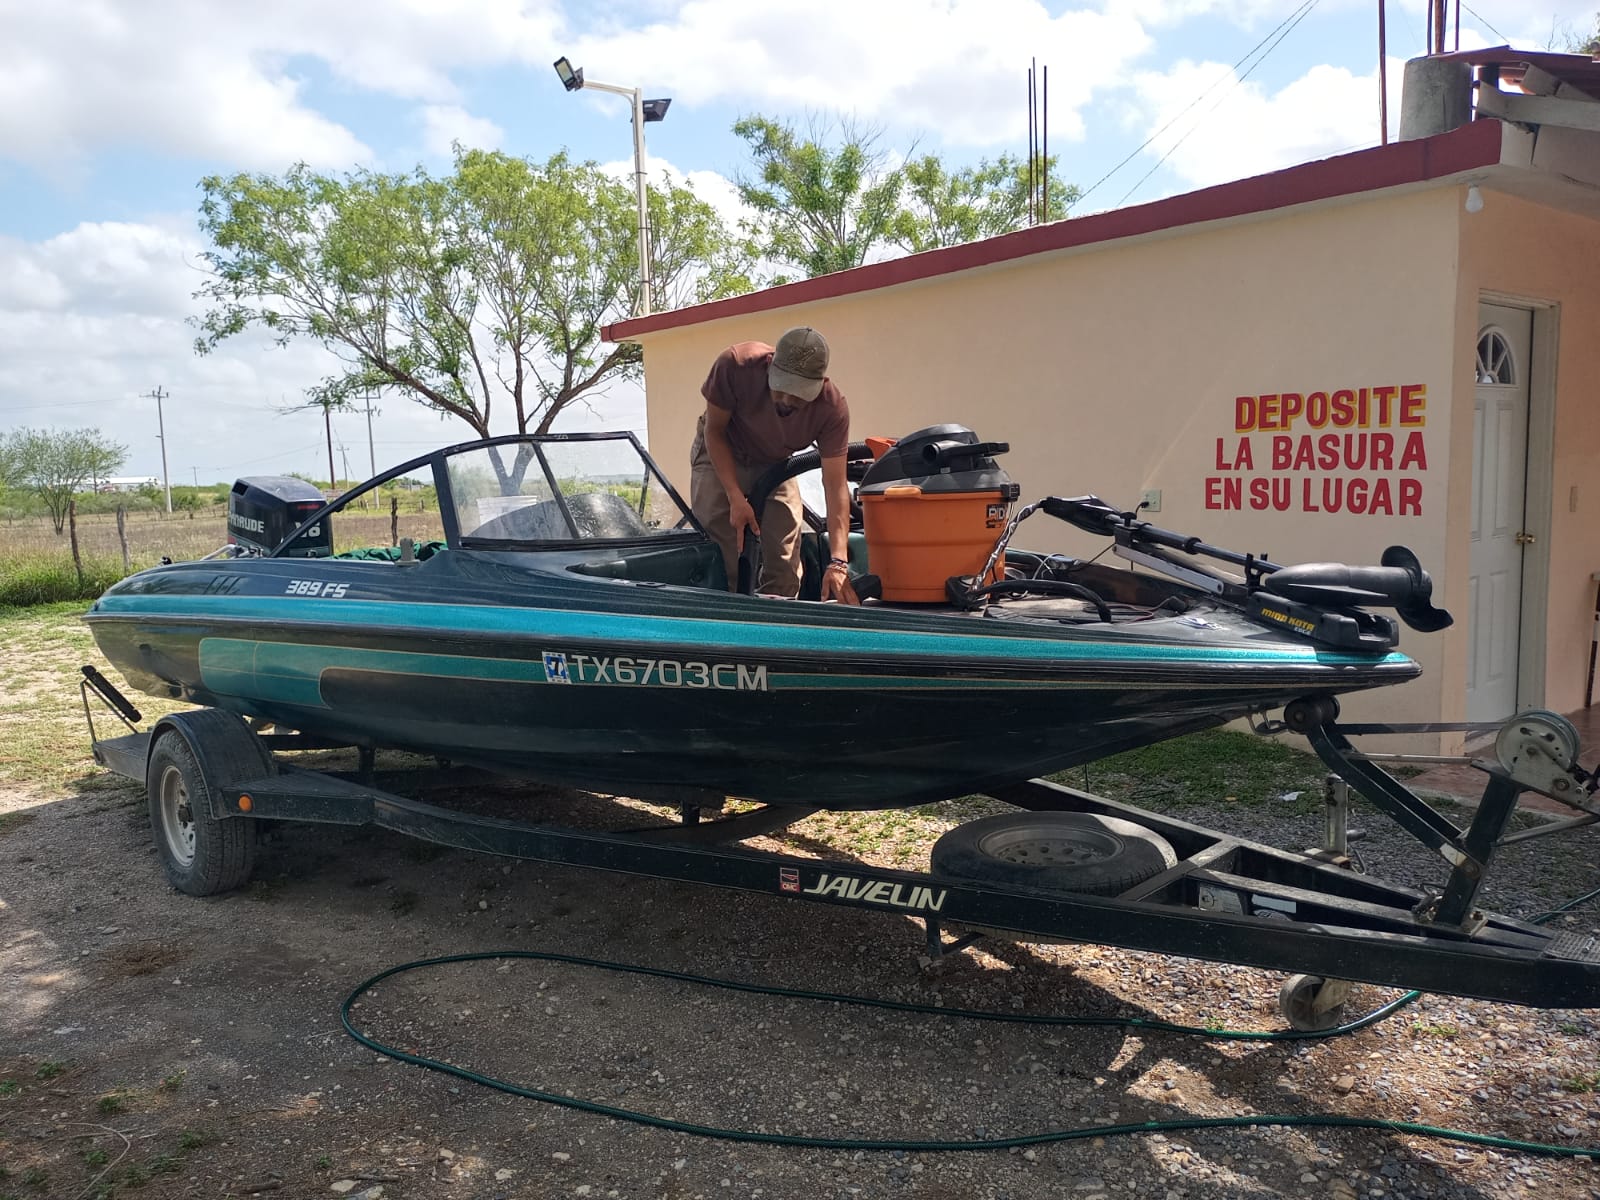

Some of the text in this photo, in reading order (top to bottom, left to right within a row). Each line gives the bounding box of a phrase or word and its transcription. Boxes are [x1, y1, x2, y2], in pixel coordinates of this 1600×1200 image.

[1235, 384, 1426, 433] DEPOSITE
[1215, 431, 1428, 471] LA BASURA
[1205, 477, 1423, 516] EN SU LUGAR
[285, 580, 351, 598] 389 FS
[571, 655, 768, 691] TX6703CM
[803, 874, 947, 911] JAVELIN
